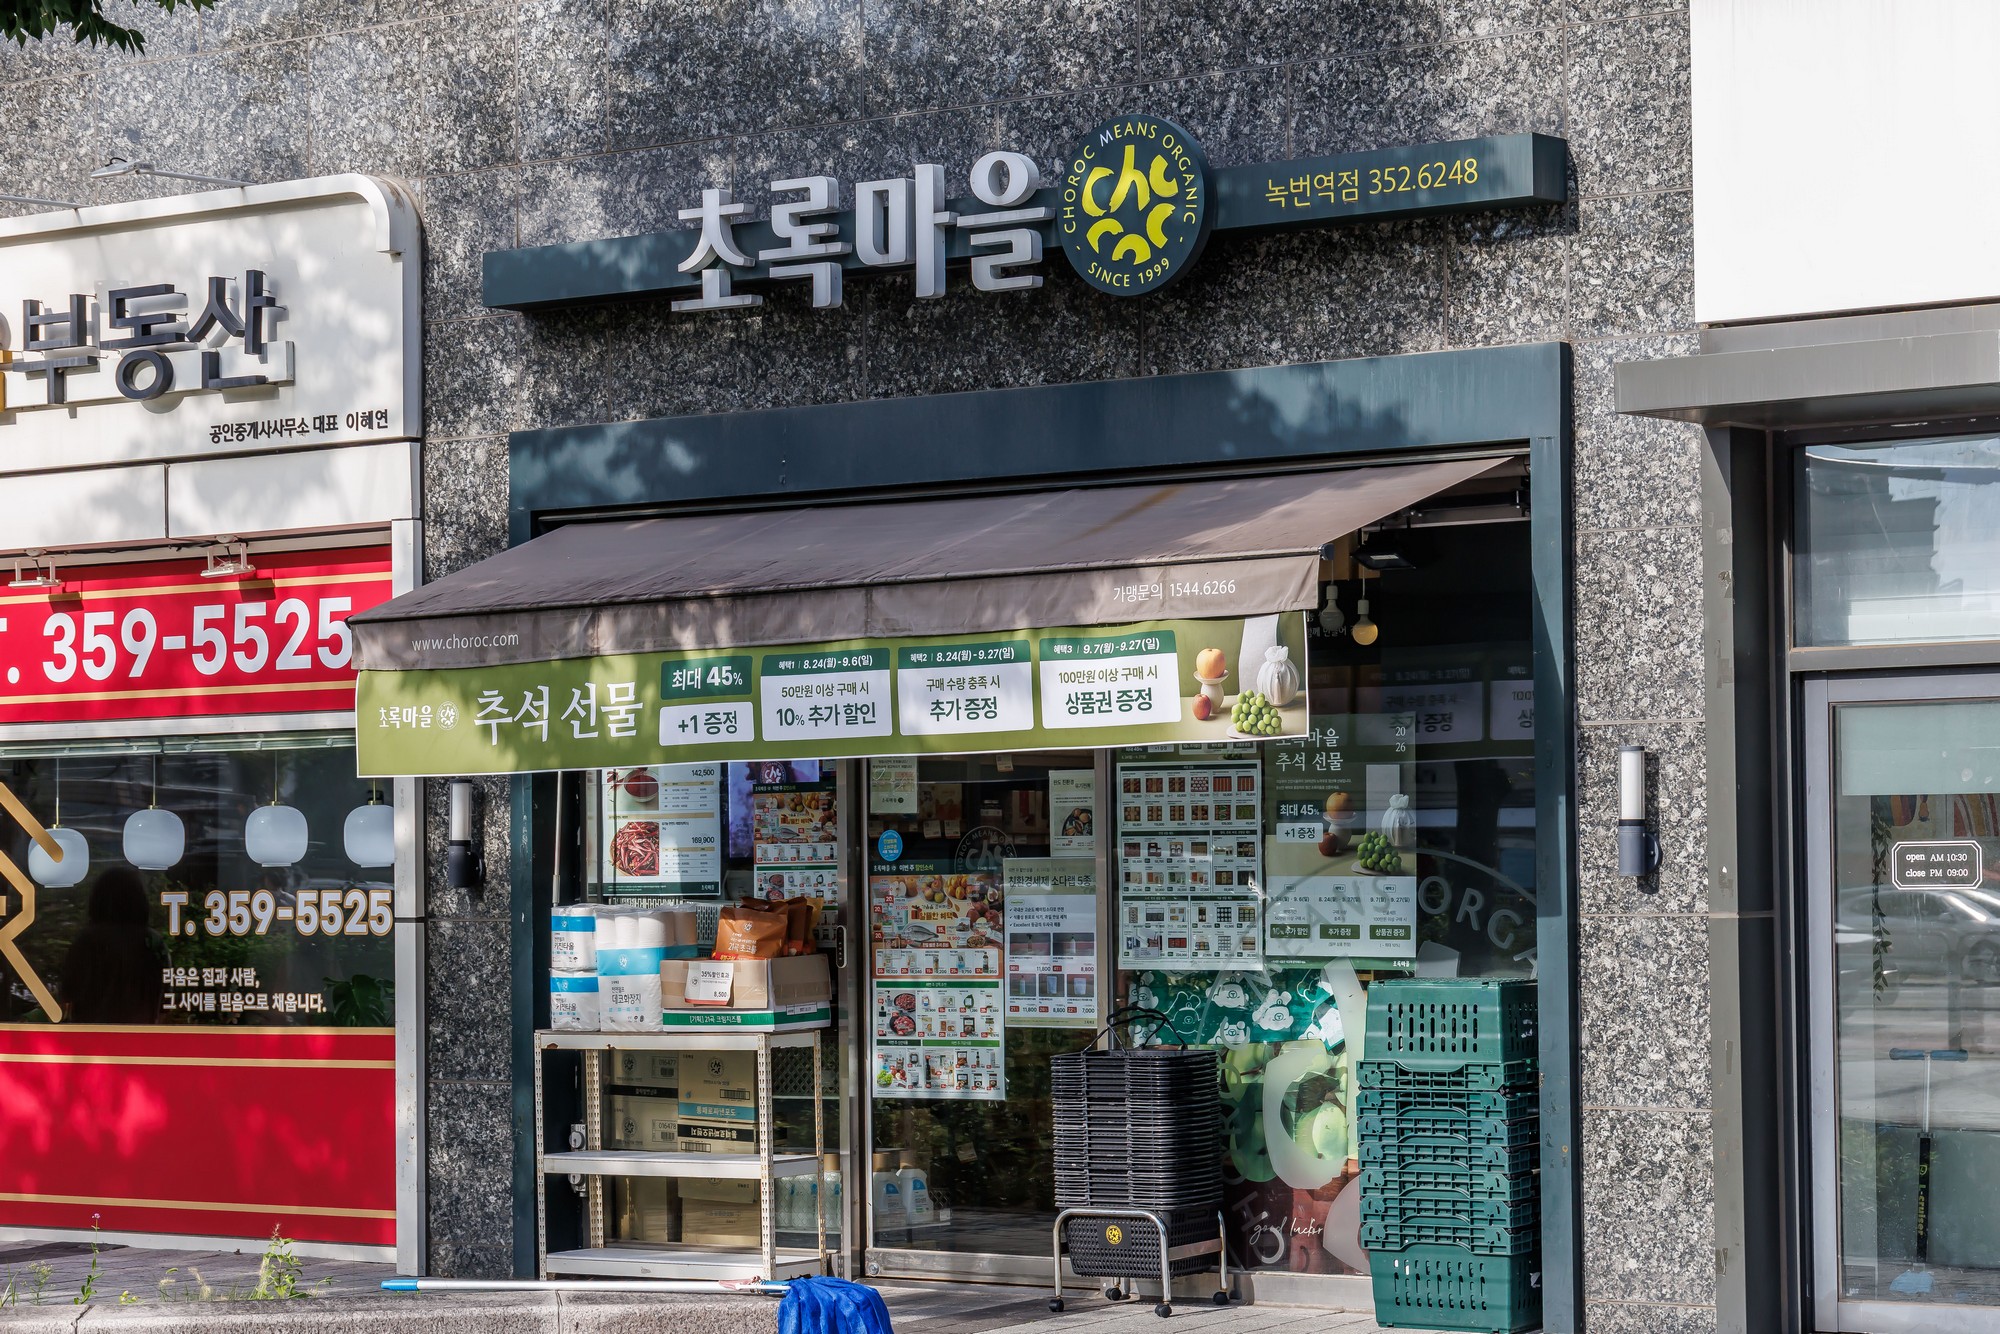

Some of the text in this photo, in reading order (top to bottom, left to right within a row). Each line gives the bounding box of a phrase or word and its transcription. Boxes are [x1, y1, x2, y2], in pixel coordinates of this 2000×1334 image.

[1063, 122, 1198, 234] CHOROC MEANS ORGANIC
[1265, 157, 1479, 209] 녹번역점 352.6248
[671, 151, 1057, 312] 초록마을
[1087, 257, 1170, 287] SINCE 1999
[13, 269, 277, 405] 부동산
[208, 408, 389, 445] 공인중개사사무소 대표 이혜연
[1113, 579, 1236, 603] 가맹문의 1544.6266
[42, 596, 353, 683] 359-5525
[412, 632, 519, 652] www.choroc.com
[1053, 644, 1074, 655] 혜택3
[778, 660, 796, 670] 혜택1
[910, 653, 928, 663] 혜택2
[671, 665, 743, 691] 최대 45%
[926, 674, 1001, 693] 구매 수량 충족 시
[1058, 665, 1159, 685] 100만원 이상 구매 시
[781, 681, 870, 699] 50만원 이상 구매 시
[930, 696, 998, 722] 추가 증정
[1065, 687, 1153, 716] 상품권 증정
[378, 704, 434, 730] 초록마을
[474, 684, 550, 746] 추석
[560, 682, 644, 740] 선물
[678, 710, 738, 736] +1 증정
[776, 702, 877, 727] 10% 추가 할인
[1395, 726, 1406, 737] 20
[1395, 742, 1406, 753] 26
[1276, 751, 1344, 772] 추석 선물
[1280, 803, 1320, 817] 최대 45%
[1284, 827, 1316, 839] +1 증정
[1905, 854, 1968, 863] open AM 10:30
[1009, 875, 1050, 887] 친환경세제
[1077, 875, 1092, 886] 5종
[1905, 868, 1969, 877] close PM 09:00
[160, 888, 395, 937] T. 359-5525
[162, 967, 261, 989] 라움은 집과 사람,
[162, 992, 328, 1013] 그 사이를 믿음으로 채웁니다.
[611, 993, 642, 1004] 데코화장지
